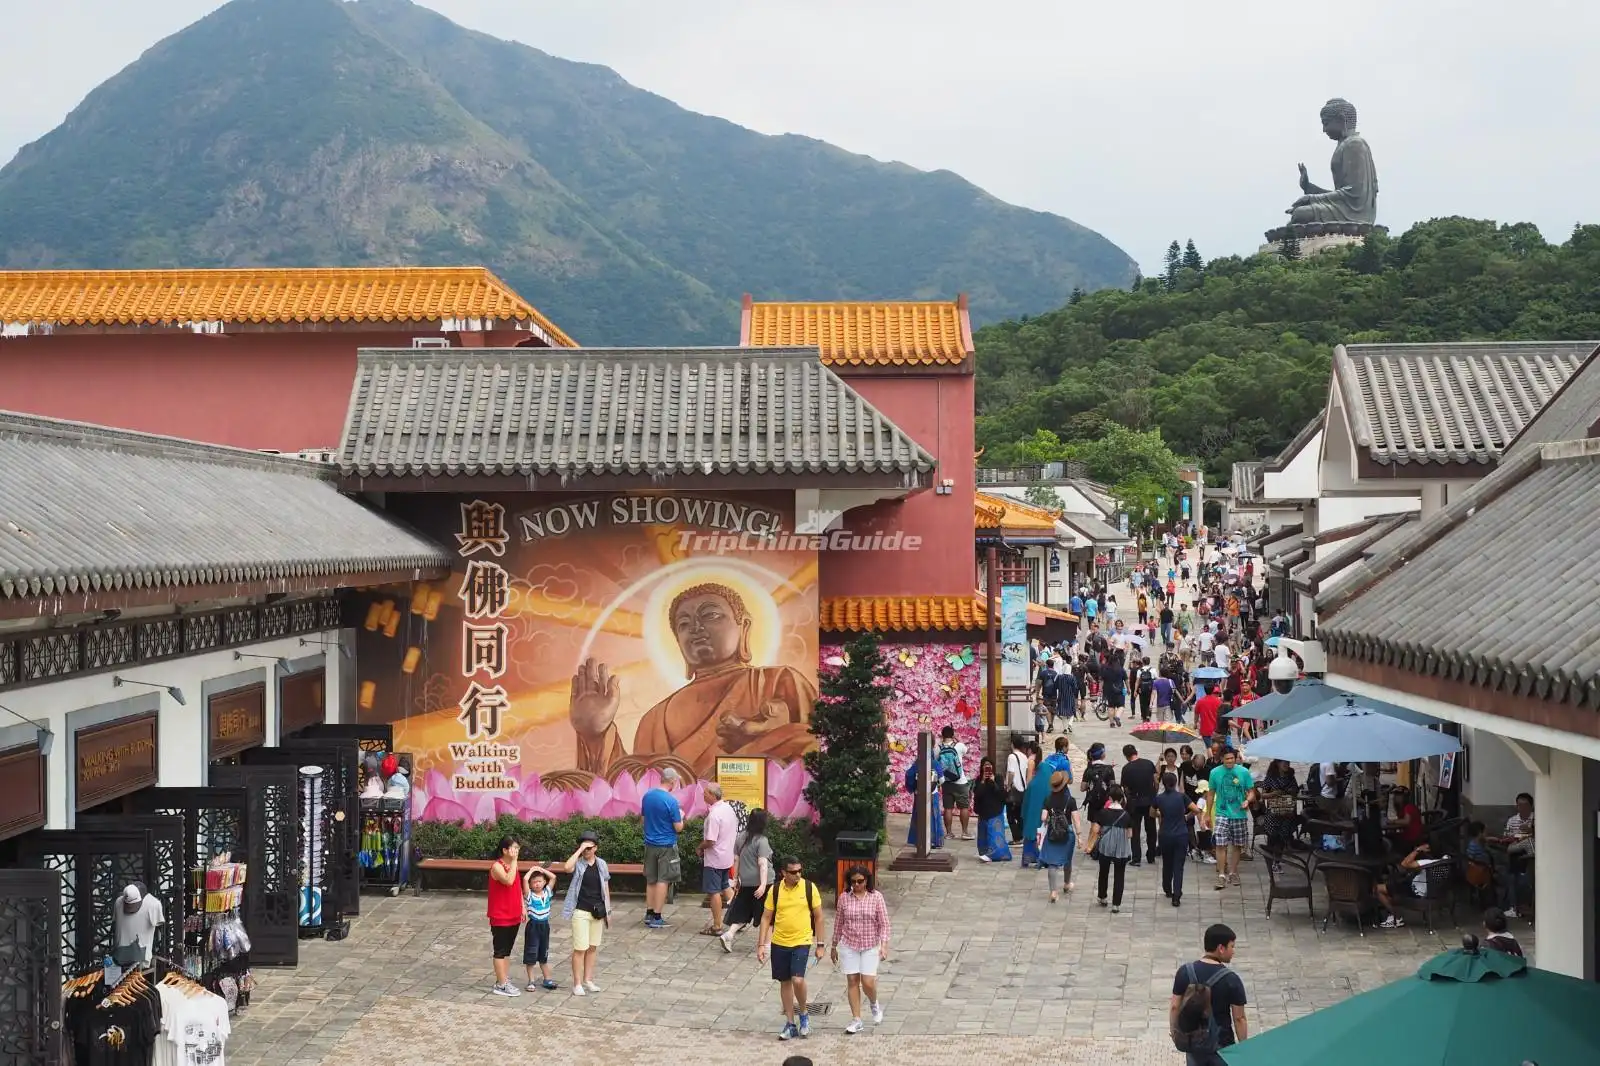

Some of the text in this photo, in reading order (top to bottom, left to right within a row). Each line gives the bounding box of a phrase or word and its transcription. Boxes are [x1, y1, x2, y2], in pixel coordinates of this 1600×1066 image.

[519, 496, 783, 543] NOW SHOWING!
[455, 500, 510, 739] 與佛同行
[451, 744, 519, 760] Walking
[466, 760, 503, 773] with
[455, 775, 516, 789] Buddha
